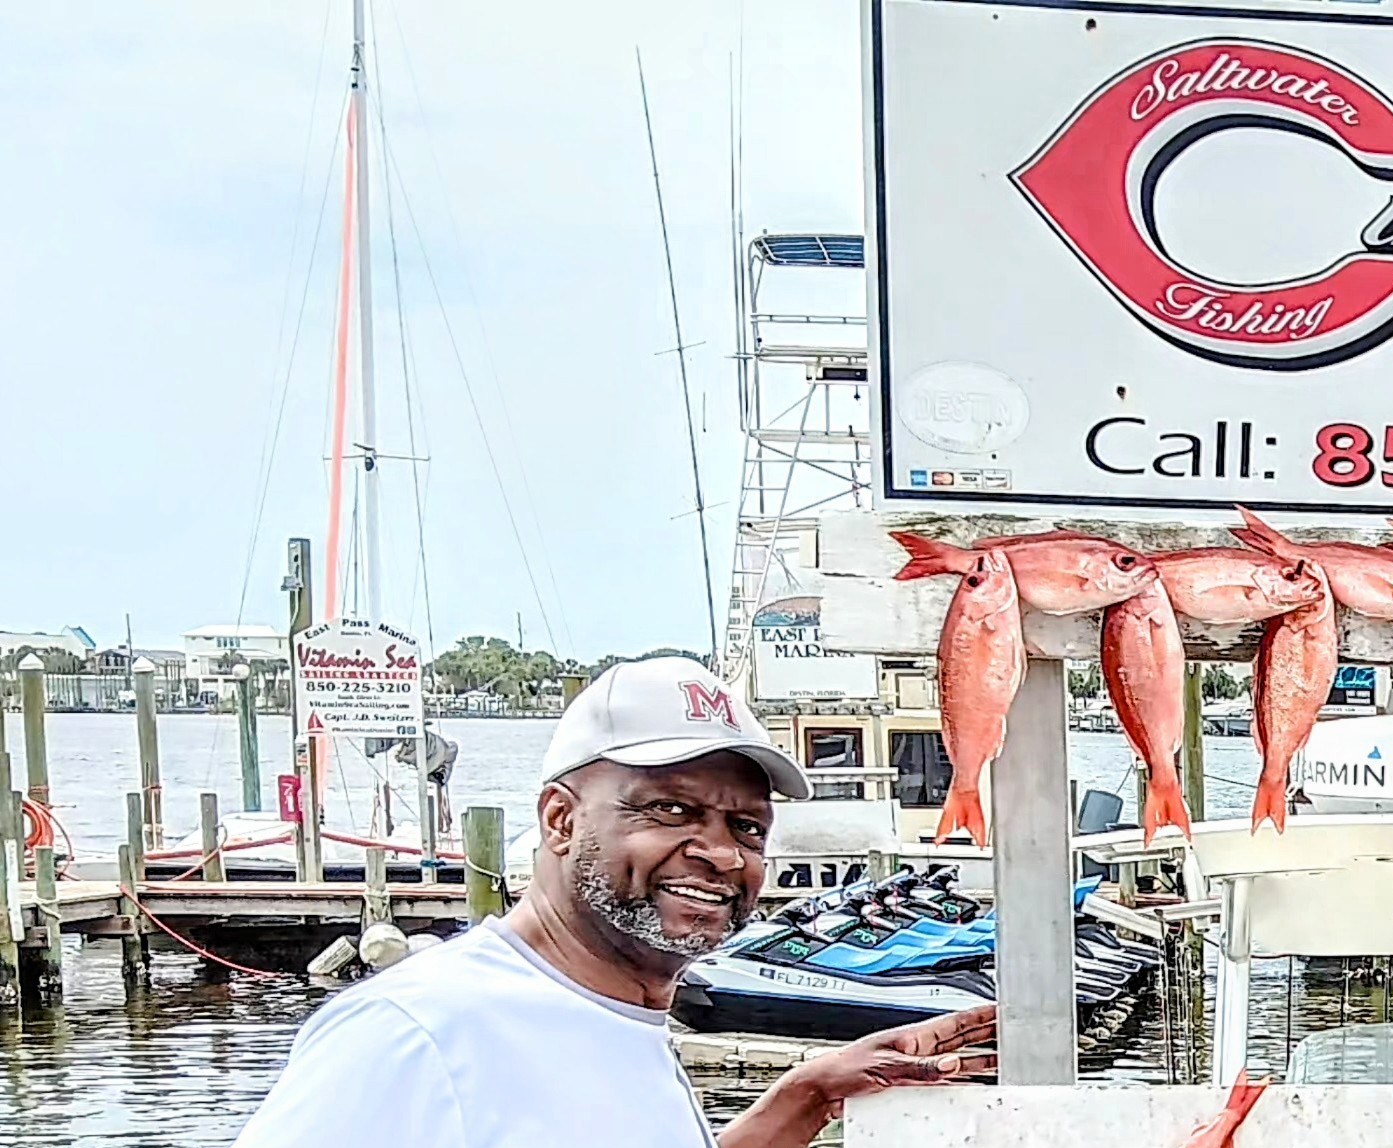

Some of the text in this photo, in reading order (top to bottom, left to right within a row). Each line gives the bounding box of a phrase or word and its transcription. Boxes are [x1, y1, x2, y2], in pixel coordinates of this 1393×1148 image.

[1130, 53, 1359, 126] Saltwater
[1155, 282, 1334, 339] Fishing
[1086, 417, 1277, 480] Call:
[304, 619, 417, 646] East Pass Marina
[761, 628, 806, 642] EAST
[298, 643, 417, 670] Vitamin Sea
[306, 681, 411, 693] 850-225-3210
[679, 680, 741, 732] M
[1302, 761, 1385, 787] ARMIN
